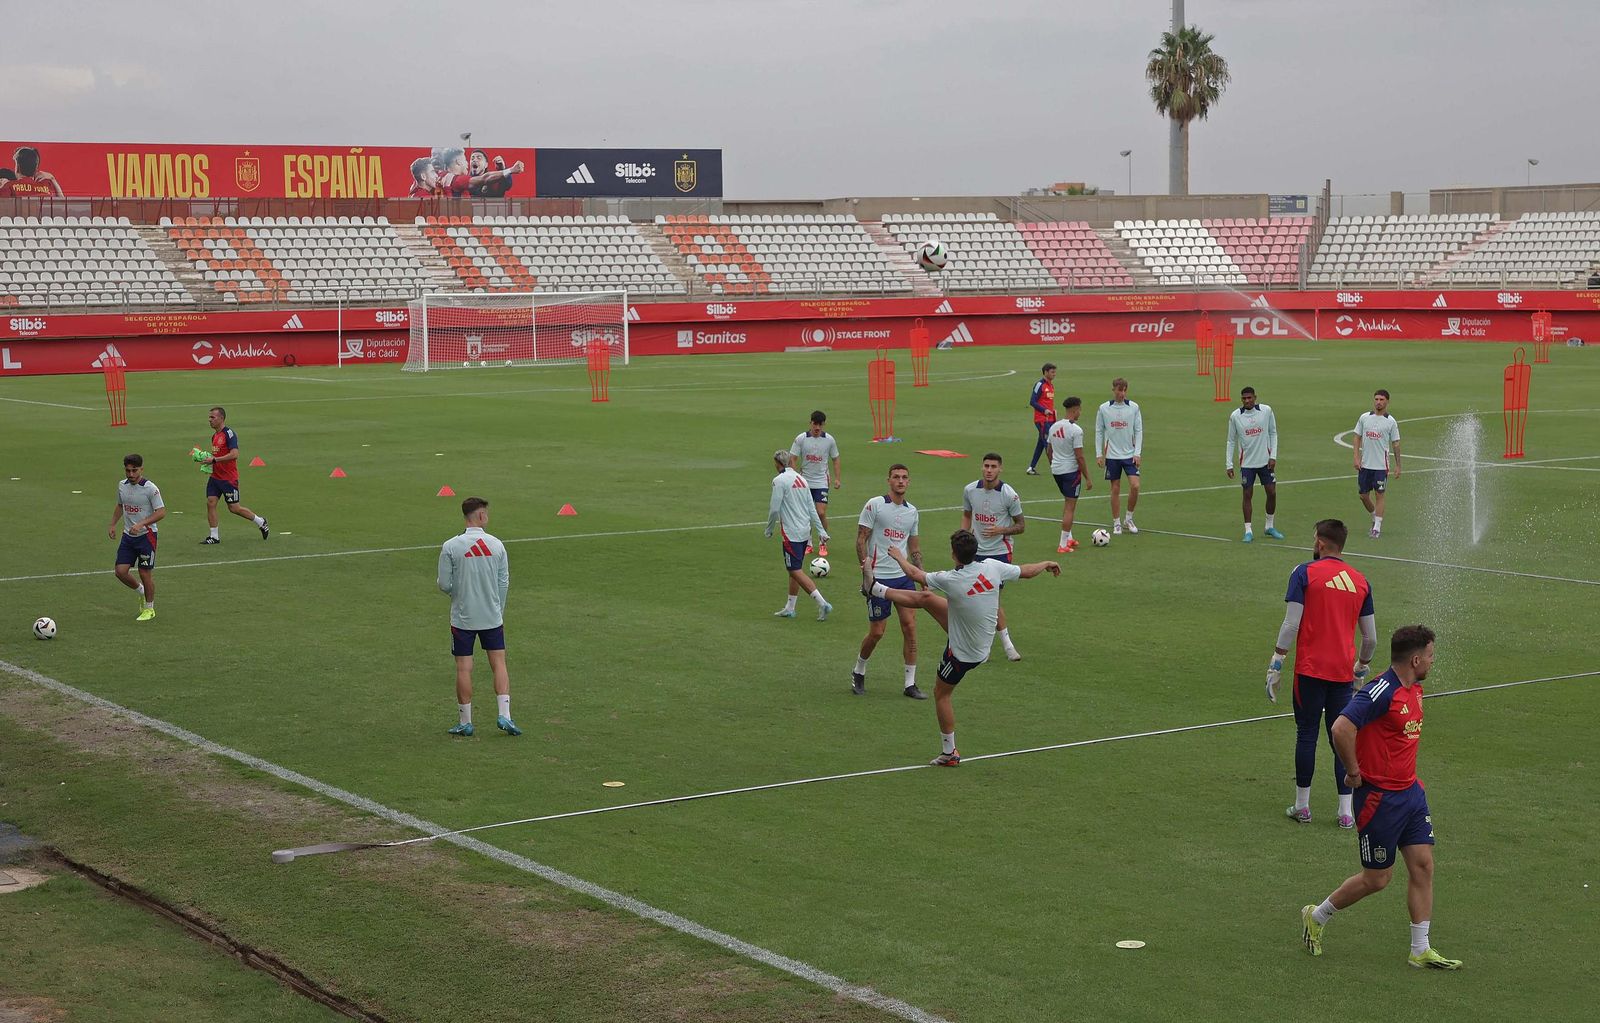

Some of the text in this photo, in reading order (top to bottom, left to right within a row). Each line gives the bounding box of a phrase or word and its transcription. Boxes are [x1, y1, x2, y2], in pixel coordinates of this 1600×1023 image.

[106, 148, 385, 199] VAMOS ESPAÑA
[615, 163, 656, 178] Silbö:
[1016, 297, 1045, 308] Silbö:
[1336, 292, 1364, 303] Silbö:
[1497, 292, 1523, 304] Silbö:
[705, 303, 737, 315] Silbö:
[375, 310, 408, 322] Silbö:
[1462, 317, 1491, 327] Diputación
[9, 318, 47, 331] Silbö:
[1029, 318, 1076, 335] Silbö:
[1130, 317, 1175, 338] renfe
[1231, 317, 1288, 335] TCL
[1357, 319, 1403, 332] Andalucía
[836, 330, 891, 339] STAGE FRONT
[1462, 327, 1486, 336] de Cádiz
[366, 338, 406, 349] Diputación
[696, 331, 747, 345] Sanitas
[218, 342, 277, 359] Andalucía
[367, 348, 400, 359] de Cádiz
